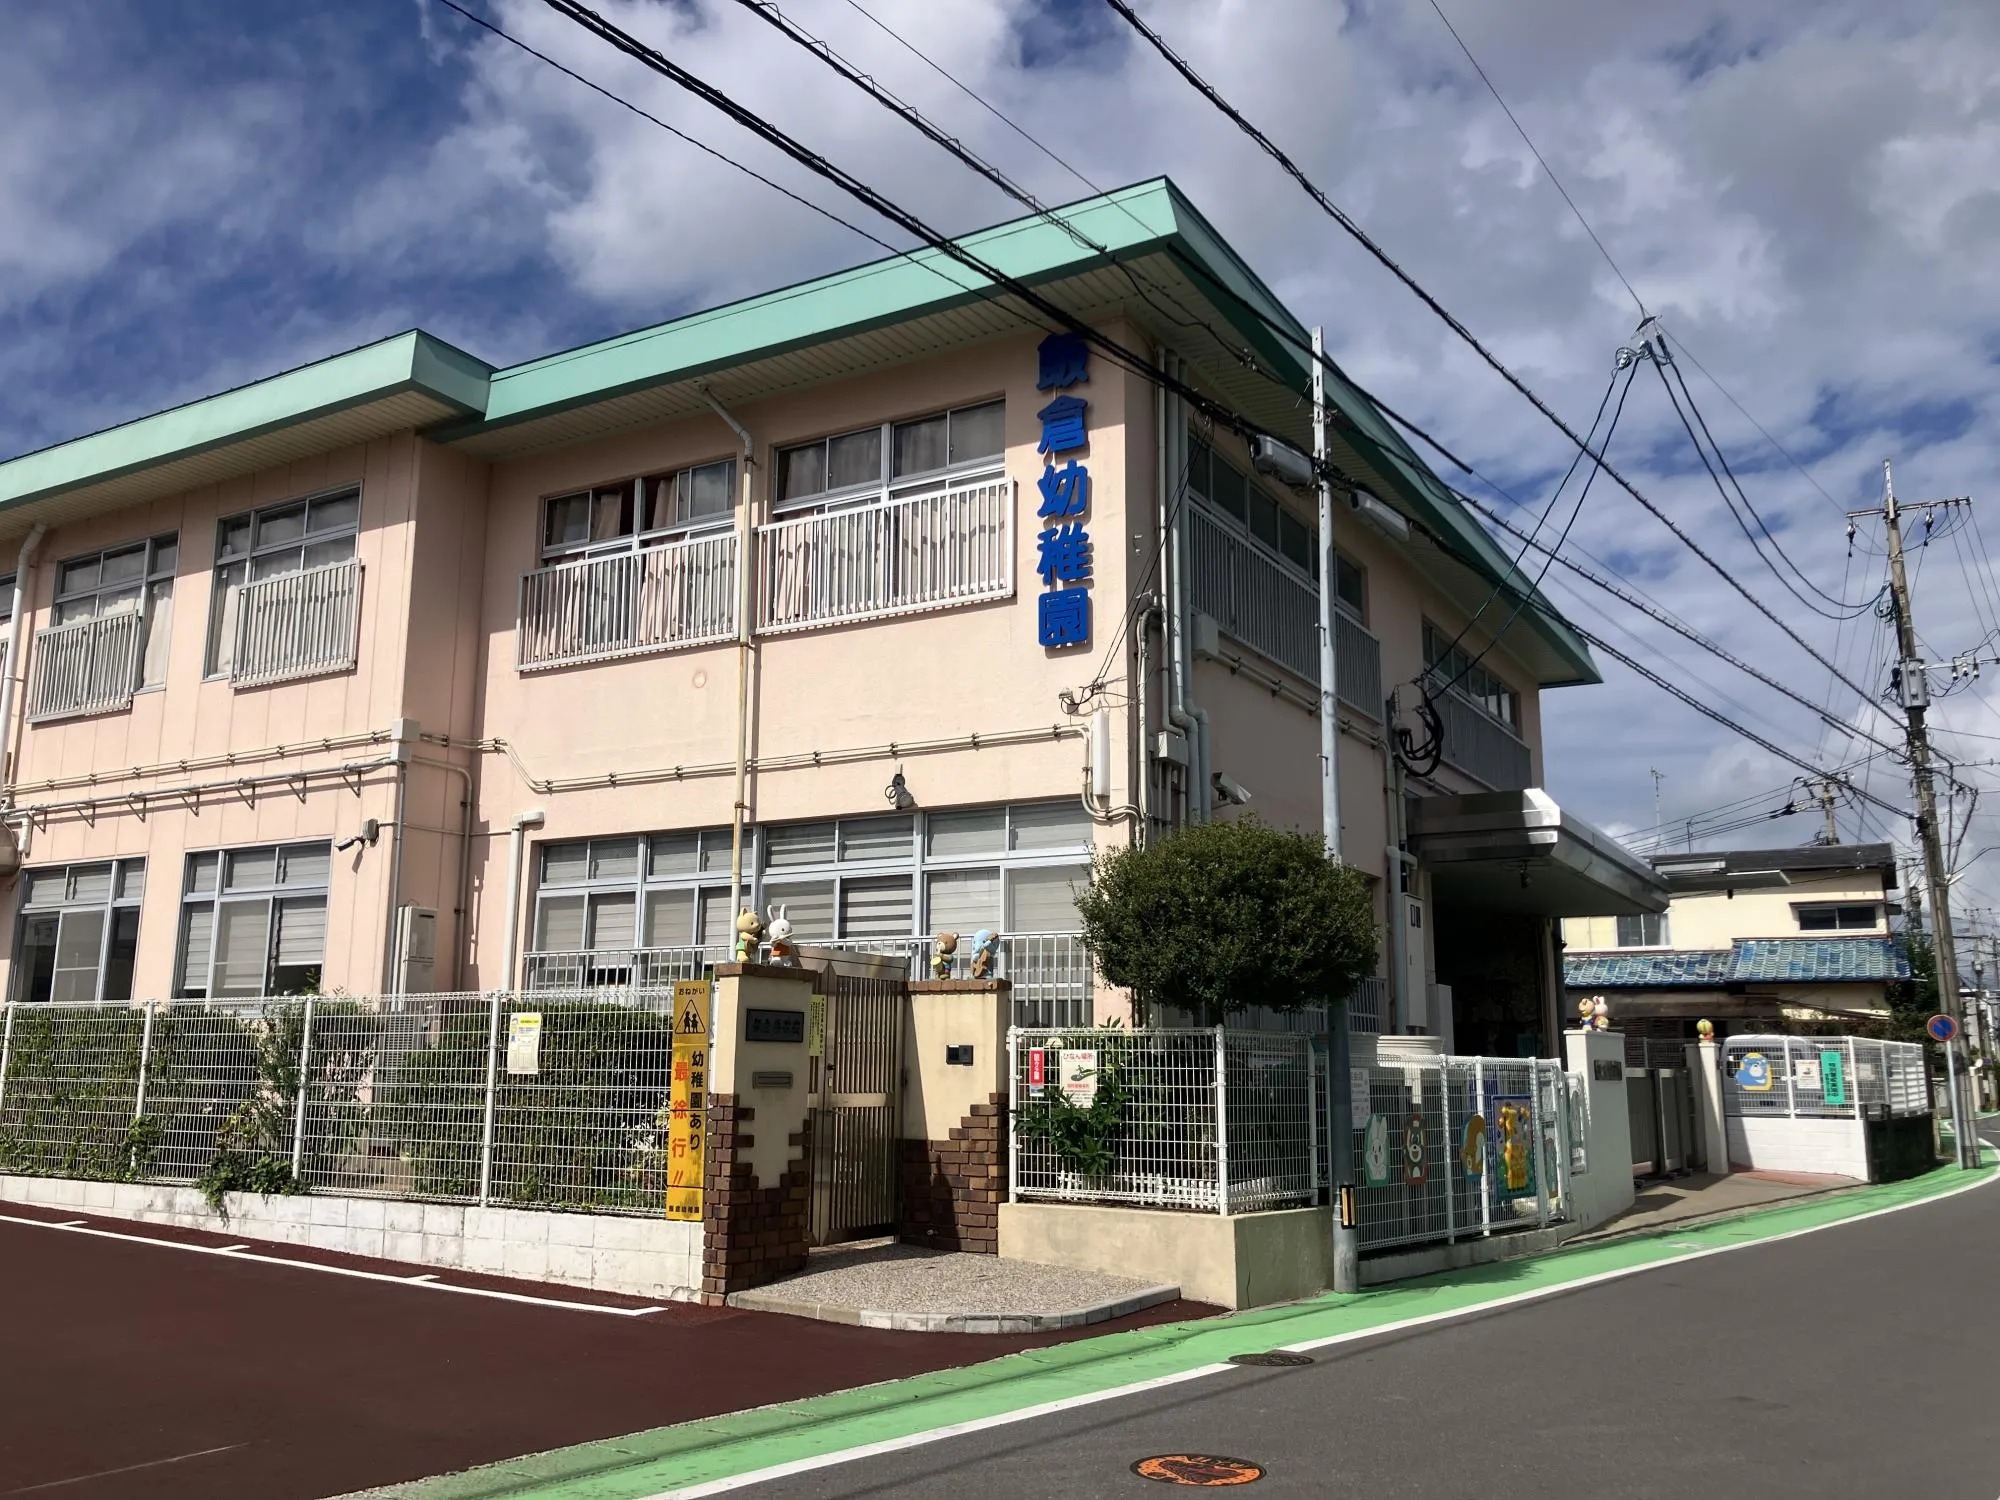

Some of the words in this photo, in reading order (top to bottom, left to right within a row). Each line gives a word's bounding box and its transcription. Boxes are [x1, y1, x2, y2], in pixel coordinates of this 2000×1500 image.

[678, 987, 705, 996] おねがい
[689, 1050, 704, 1151] 幼稚園あり
